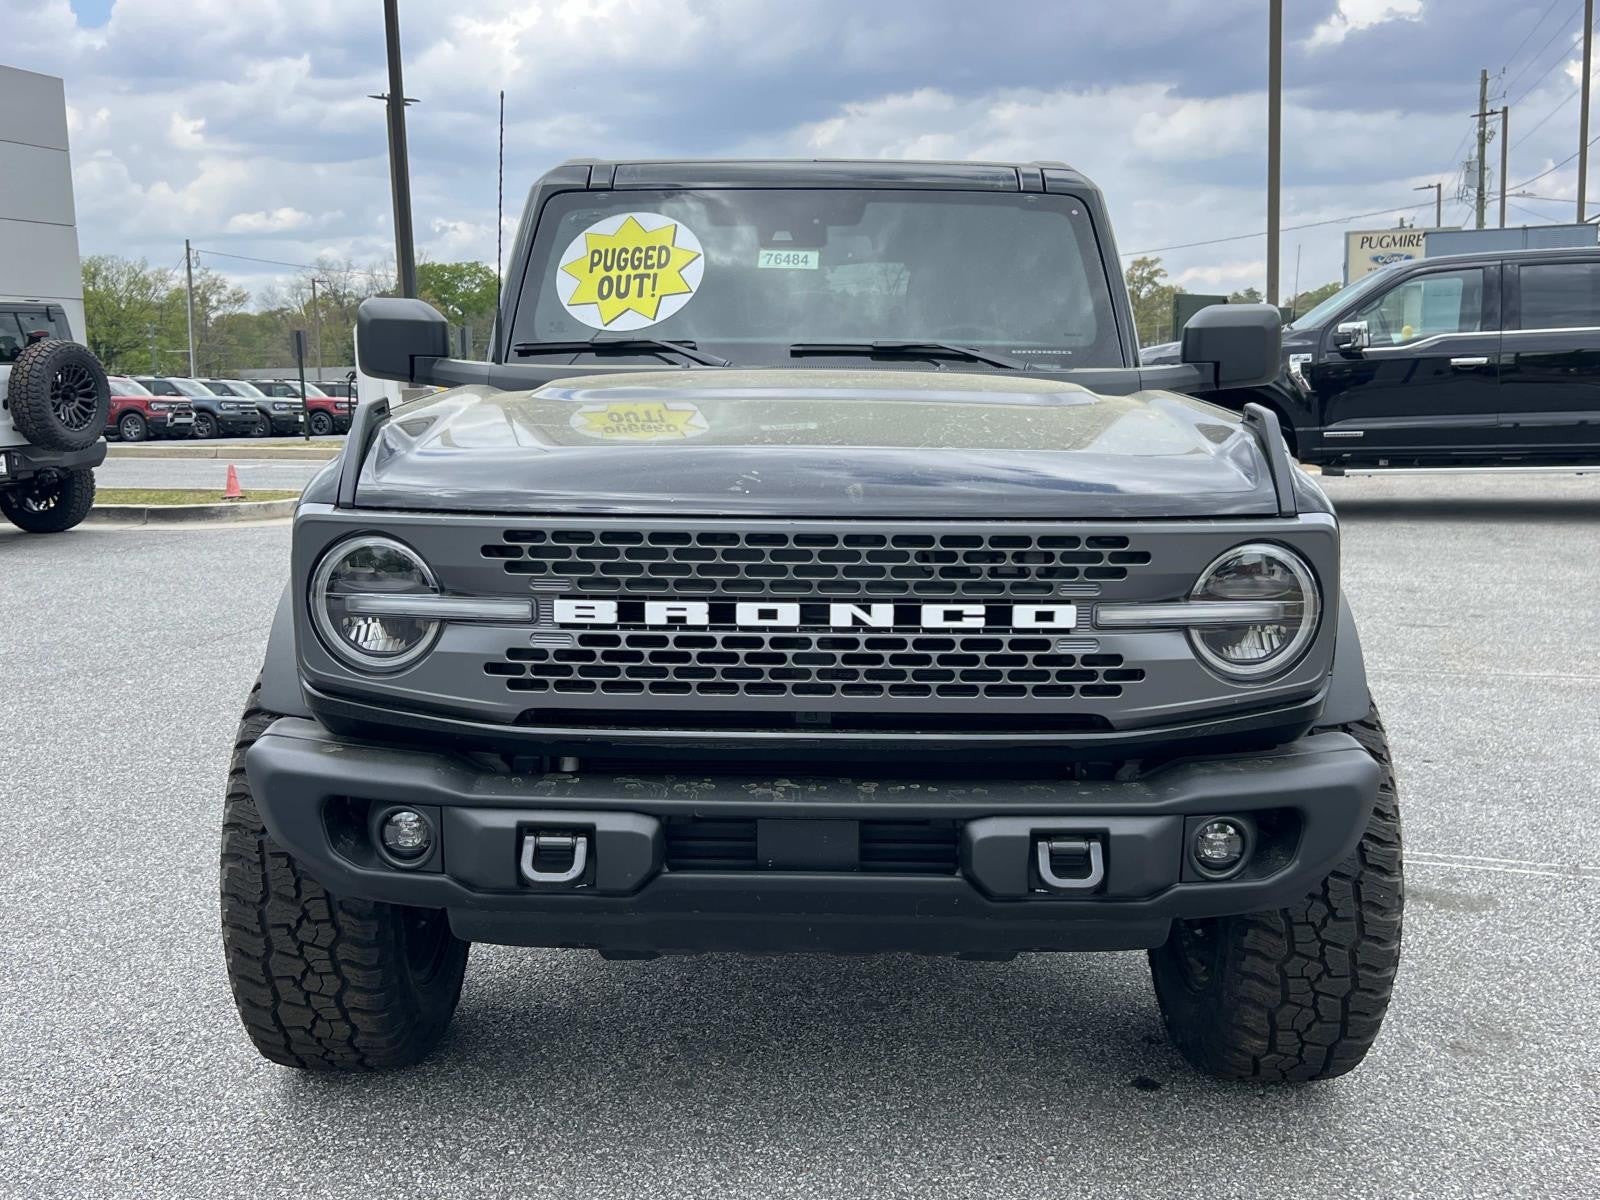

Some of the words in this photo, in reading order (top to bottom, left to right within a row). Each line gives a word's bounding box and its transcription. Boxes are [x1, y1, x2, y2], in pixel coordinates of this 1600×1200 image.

[1360, 233, 1424, 250] PUGMIRE
[588, 245, 671, 274] PUGGED
[766, 252, 809, 266] 76484
[597, 273, 658, 301] OUT!
[553, 599, 1077, 629] BRONCO
